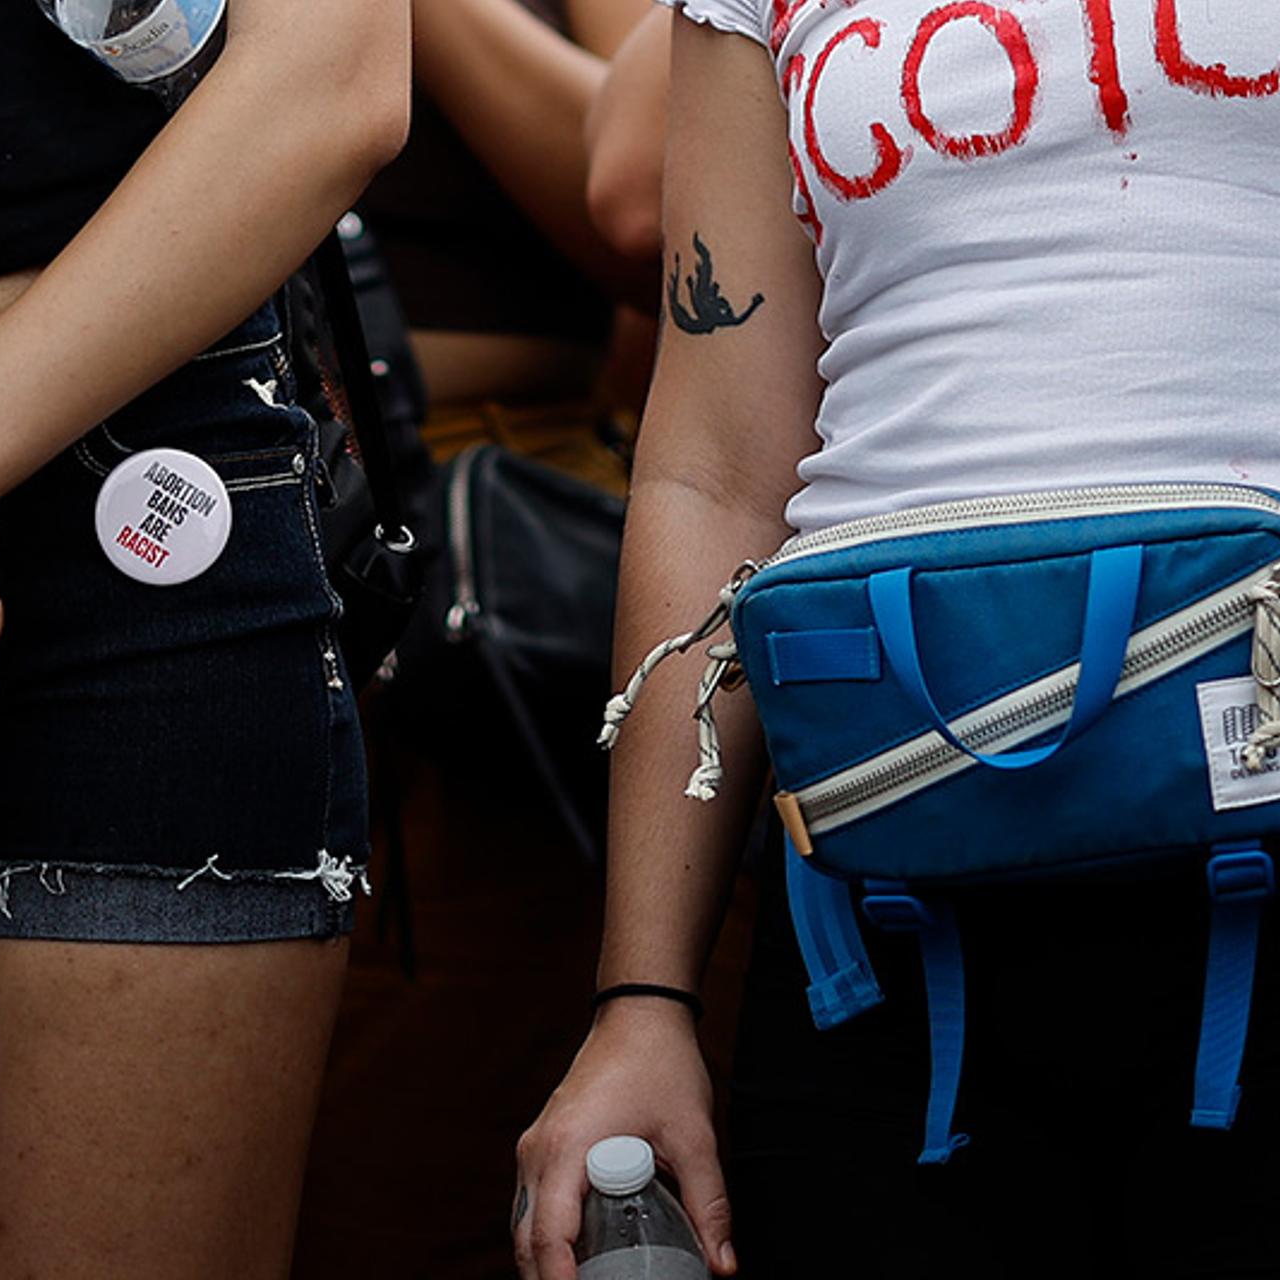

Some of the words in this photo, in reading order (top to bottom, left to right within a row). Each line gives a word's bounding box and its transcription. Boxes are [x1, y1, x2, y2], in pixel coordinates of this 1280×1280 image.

[143, 460, 218, 517] ABORTION
[147, 489, 190, 526] BANS
[116, 524, 170, 568] RACIST
[138, 513, 173, 543] ARE
